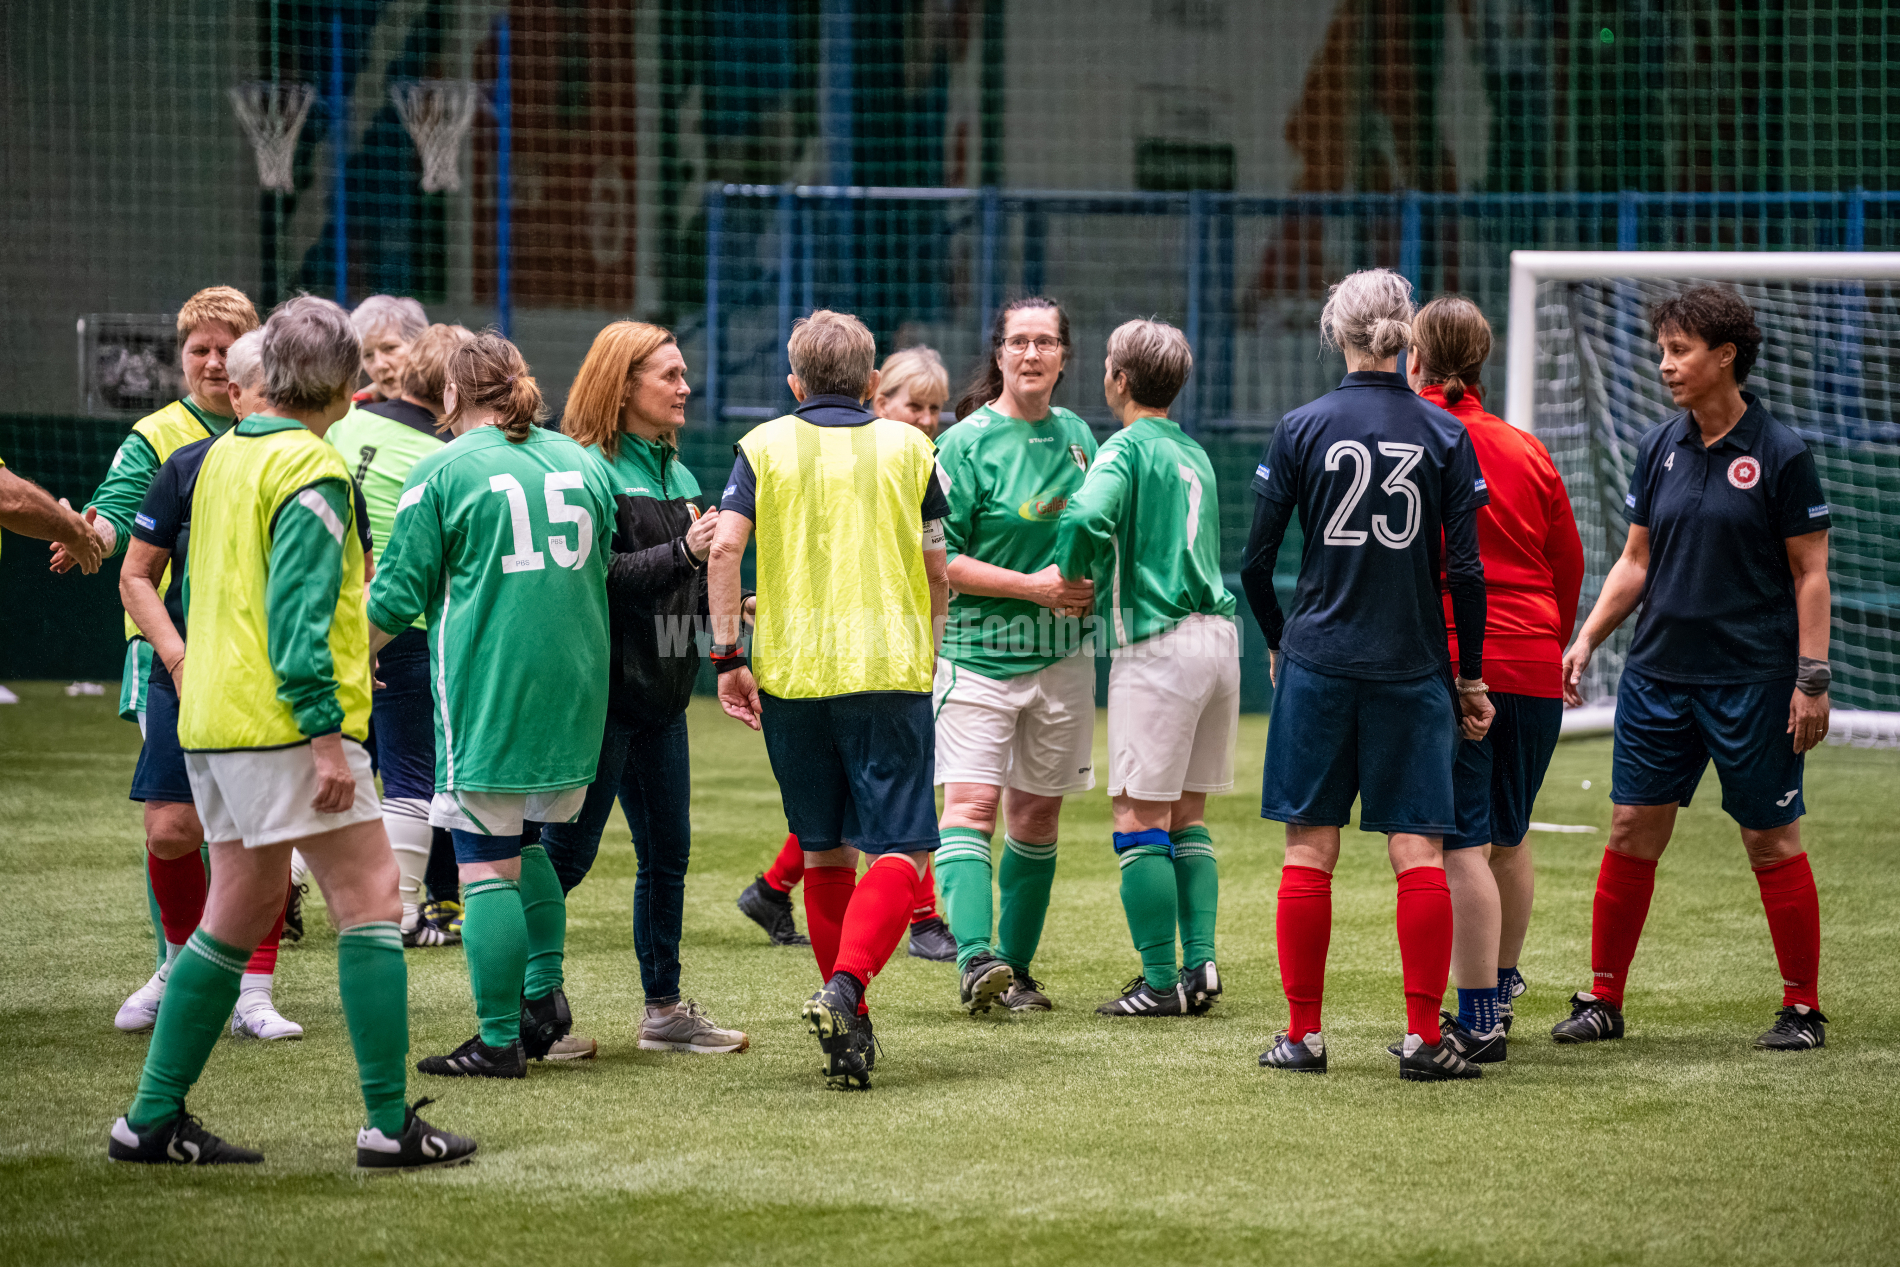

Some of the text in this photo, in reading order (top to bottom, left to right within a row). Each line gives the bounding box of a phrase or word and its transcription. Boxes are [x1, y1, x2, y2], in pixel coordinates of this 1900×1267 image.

[1177, 463, 1203, 553] 7
[1323, 440, 1425, 549] 23
[1664, 452, 1675, 471] 4
[489, 471, 593, 574] 15
